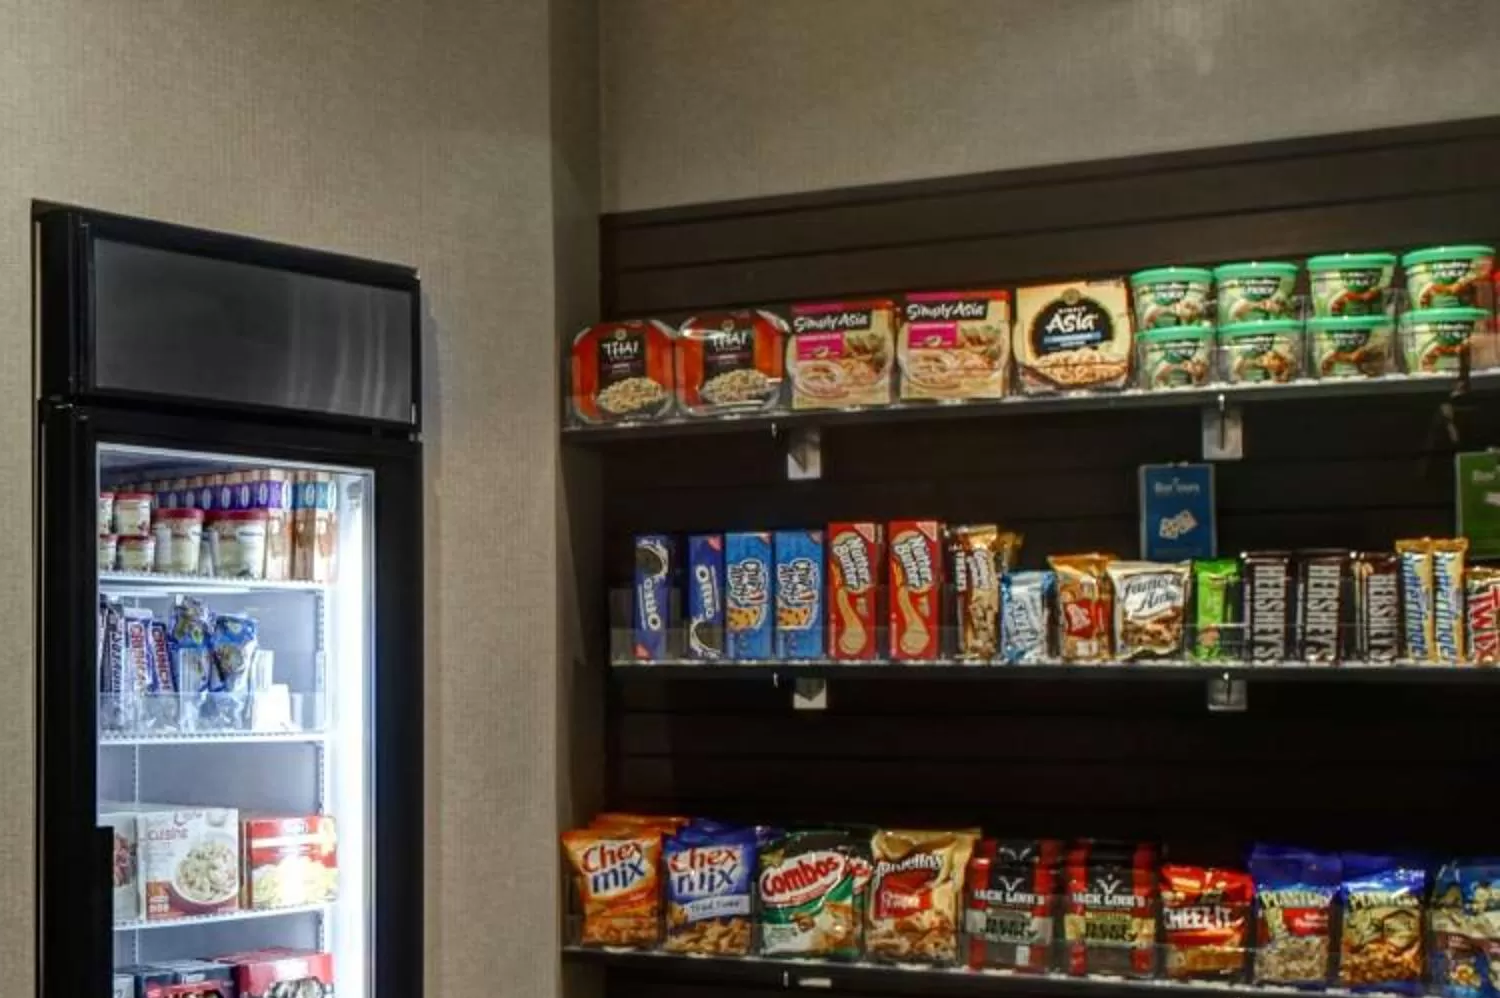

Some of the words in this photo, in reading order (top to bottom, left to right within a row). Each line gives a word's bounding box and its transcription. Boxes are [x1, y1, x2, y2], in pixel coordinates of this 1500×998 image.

[794, 316, 836, 333] Simply
[837, 312, 869, 328] Asia
[906, 303, 951, 320] Simply
[952, 300, 985, 317] Asia
[1045, 313, 1095, 333] Asia
[602, 340, 639, 357] THAI
[695, 564, 714, 618] OREO
[581, 840, 645, 872] Chex
[667, 845, 738, 873] Chex
[591, 861, 646, 894] mix
[675, 865, 736, 896] mix
[761, 854, 839, 897] Combos
